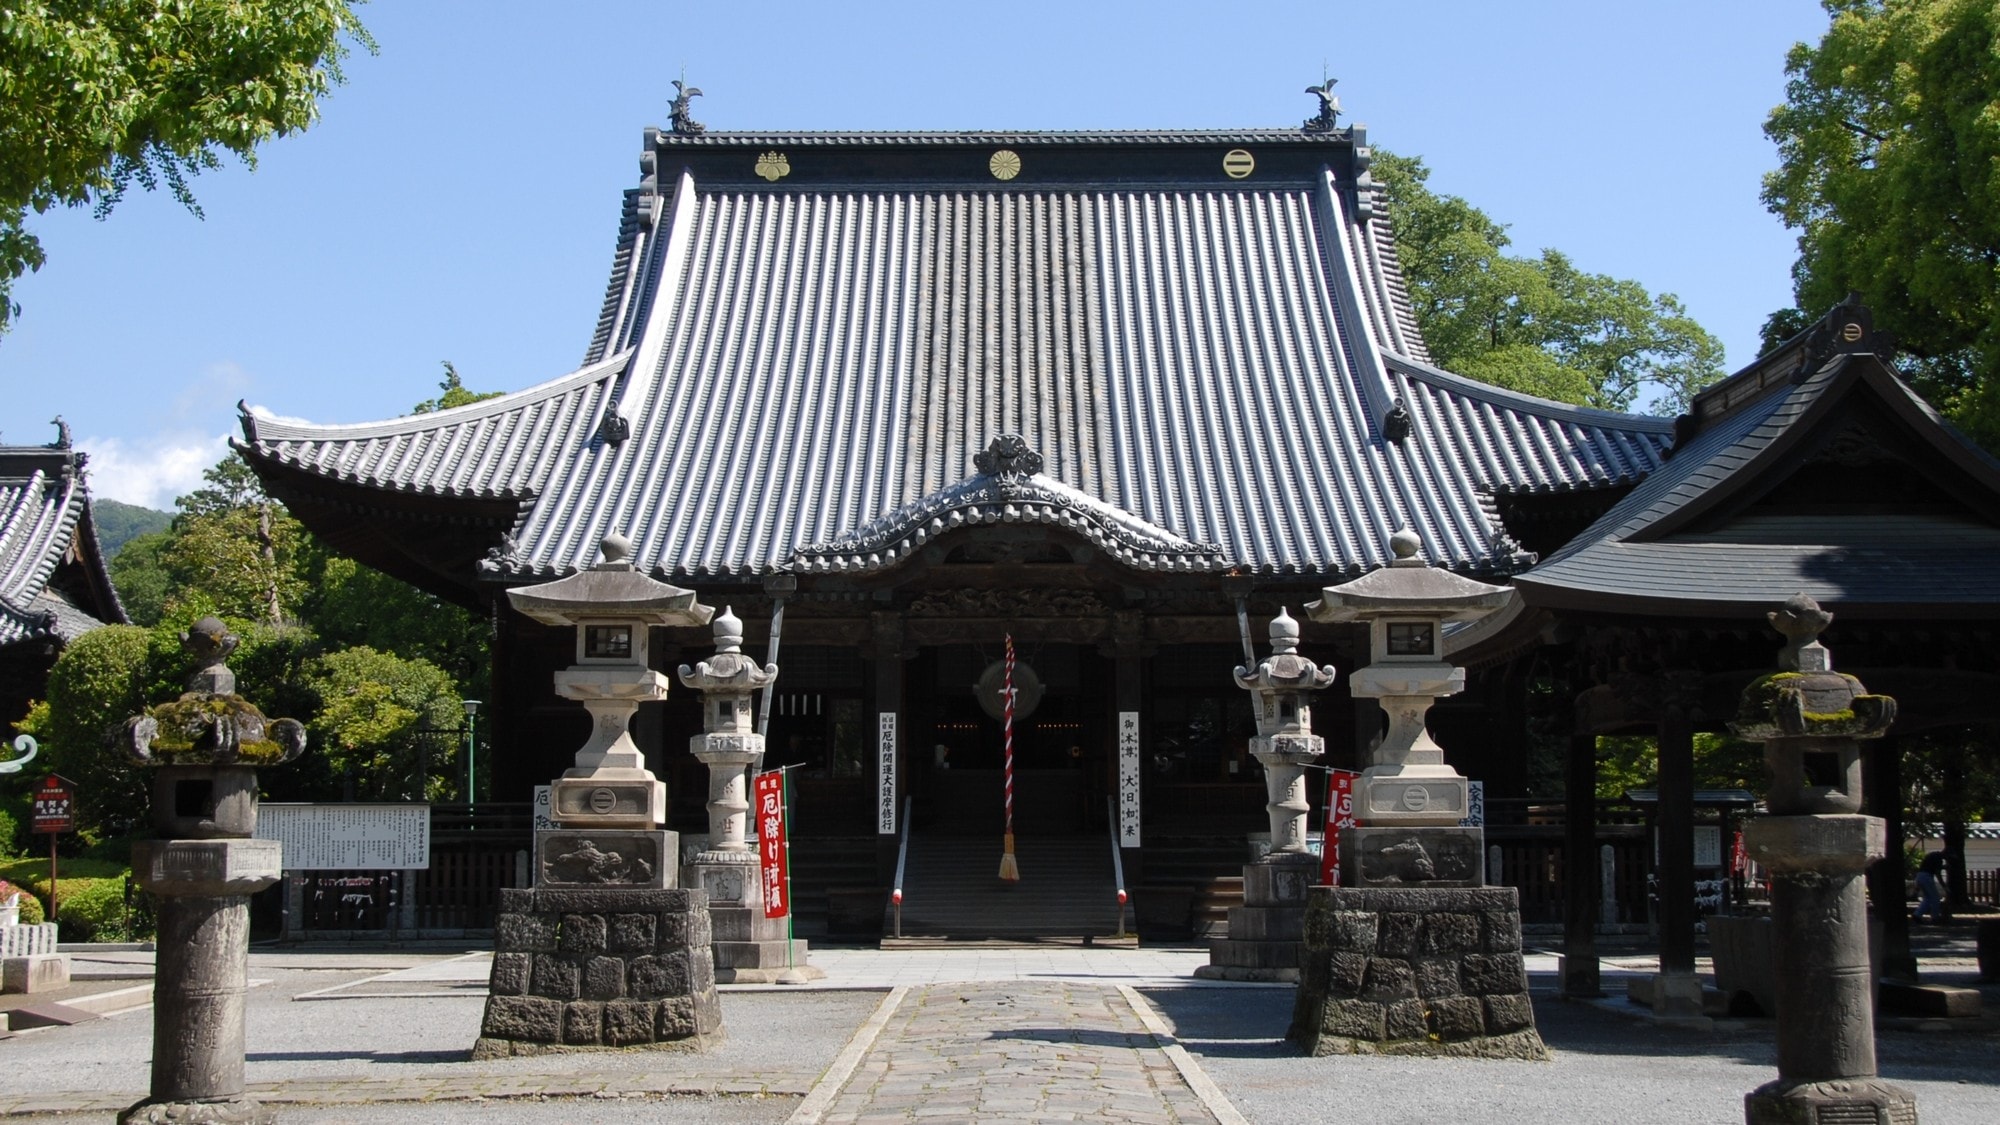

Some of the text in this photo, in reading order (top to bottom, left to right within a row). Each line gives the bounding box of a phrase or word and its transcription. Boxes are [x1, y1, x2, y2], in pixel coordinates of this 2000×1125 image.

[762, 793, 782, 909] 厄除け祈願
